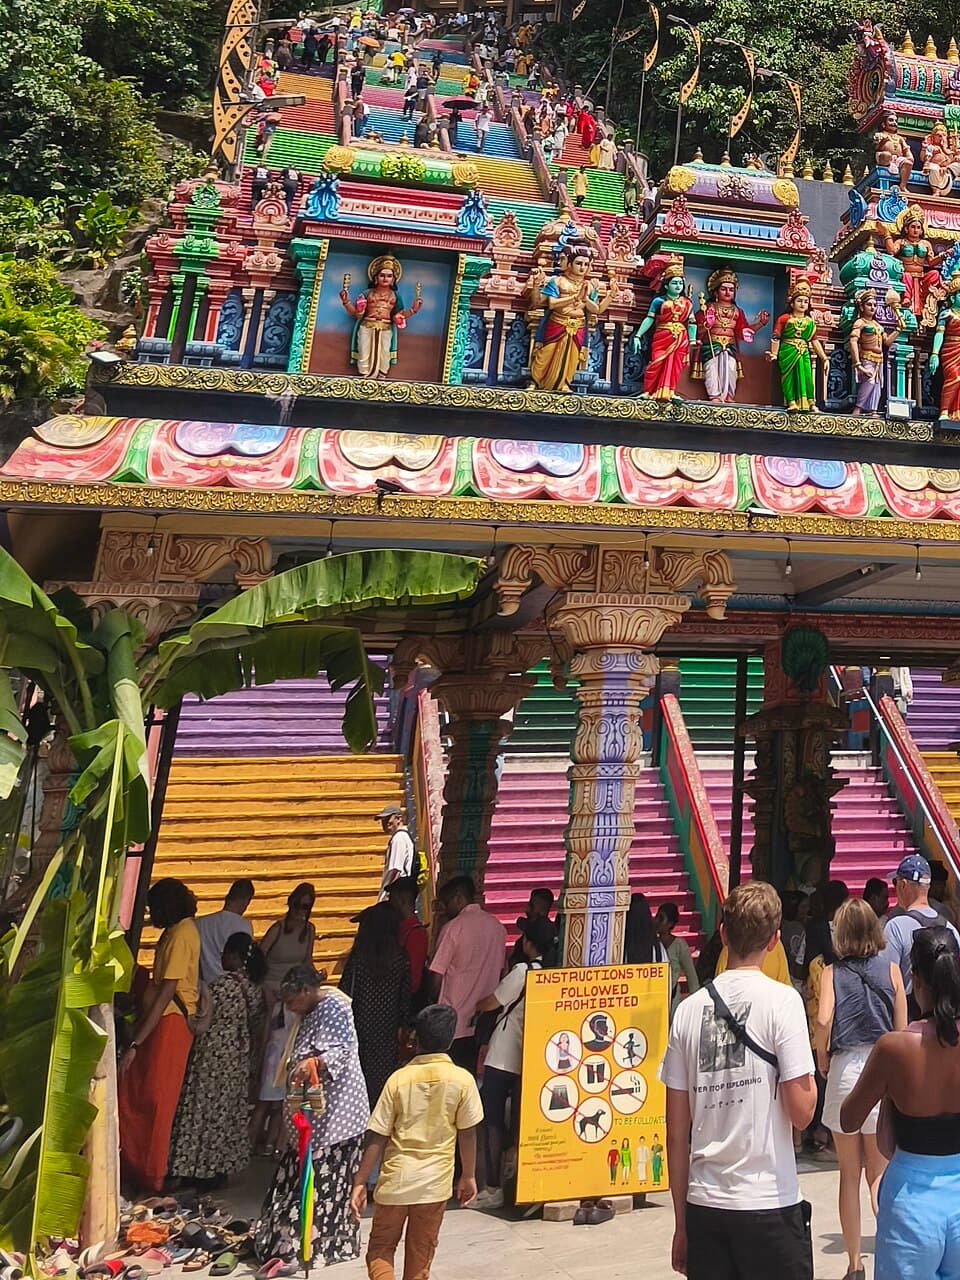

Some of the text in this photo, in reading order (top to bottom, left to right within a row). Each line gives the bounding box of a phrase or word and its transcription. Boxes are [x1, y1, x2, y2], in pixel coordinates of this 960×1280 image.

[535, 968, 634, 984] INSTRUCTIONS
[560, 983, 629, 998] FOLLOWED
[554, 995, 639, 1012] PROHIBITED
